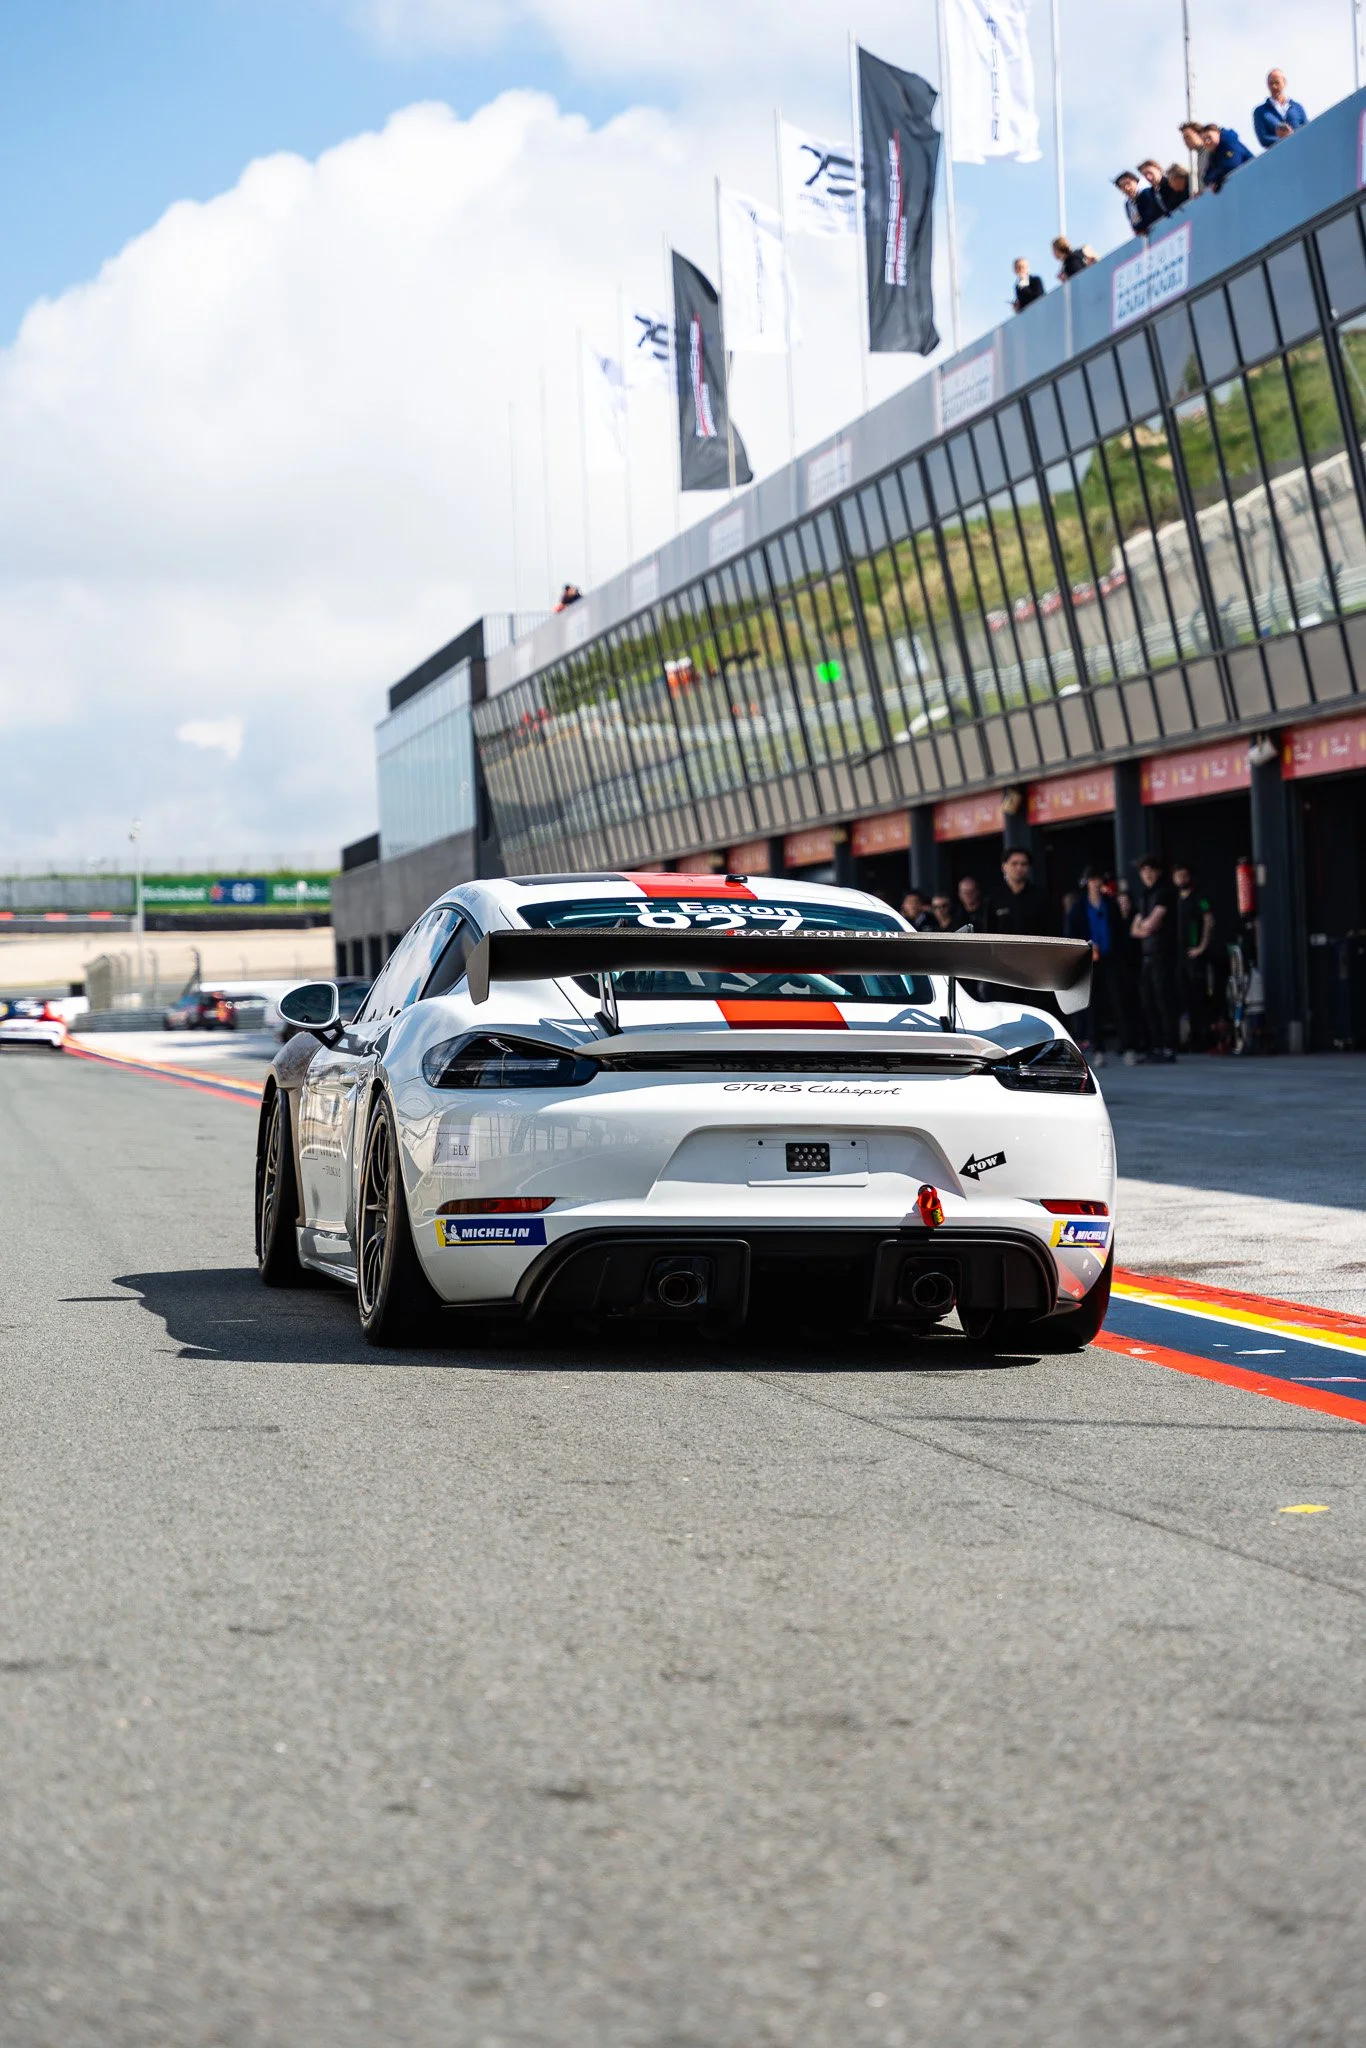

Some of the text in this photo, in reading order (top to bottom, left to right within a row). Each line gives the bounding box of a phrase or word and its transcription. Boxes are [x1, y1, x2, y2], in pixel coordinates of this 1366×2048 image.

[626, 902, 802, 917] T. Eaton
[803, 930, 846, 938] FOR
[855, 931, 899, 939] FUN
[808, 1085, 902, 1097] Clubsport
[967, 1155, 998, 1173] TOW
[461, 1228, 530, 1238] MICHELIN
[1075, 1231, 1107, 1240] MICHELIN
